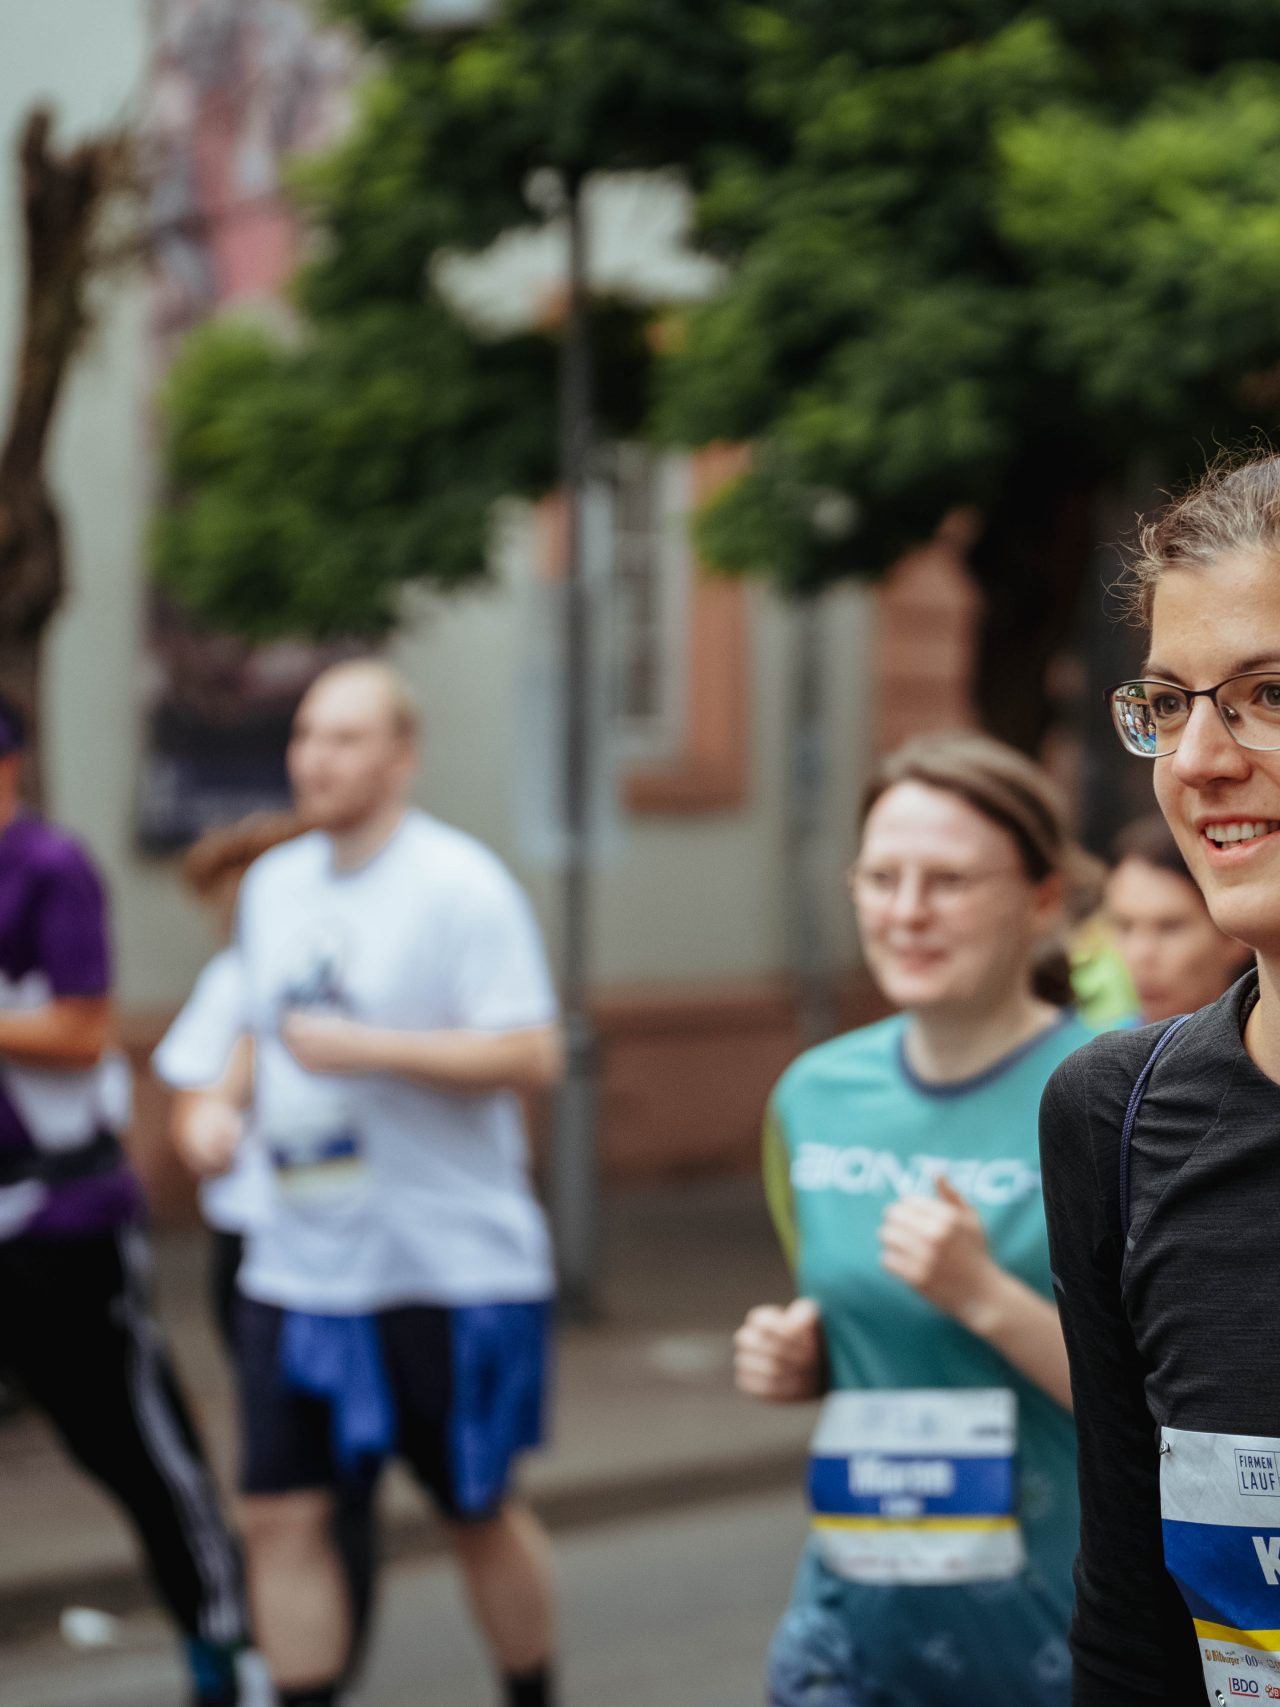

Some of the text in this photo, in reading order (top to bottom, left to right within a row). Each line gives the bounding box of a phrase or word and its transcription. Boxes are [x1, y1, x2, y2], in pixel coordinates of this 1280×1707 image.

[1239, 1455, 1273, 1469] FIRMEN
[1241, 1471, 1275, 1490] LAUF
[1231, 1677, 1259, 1693] BDO
